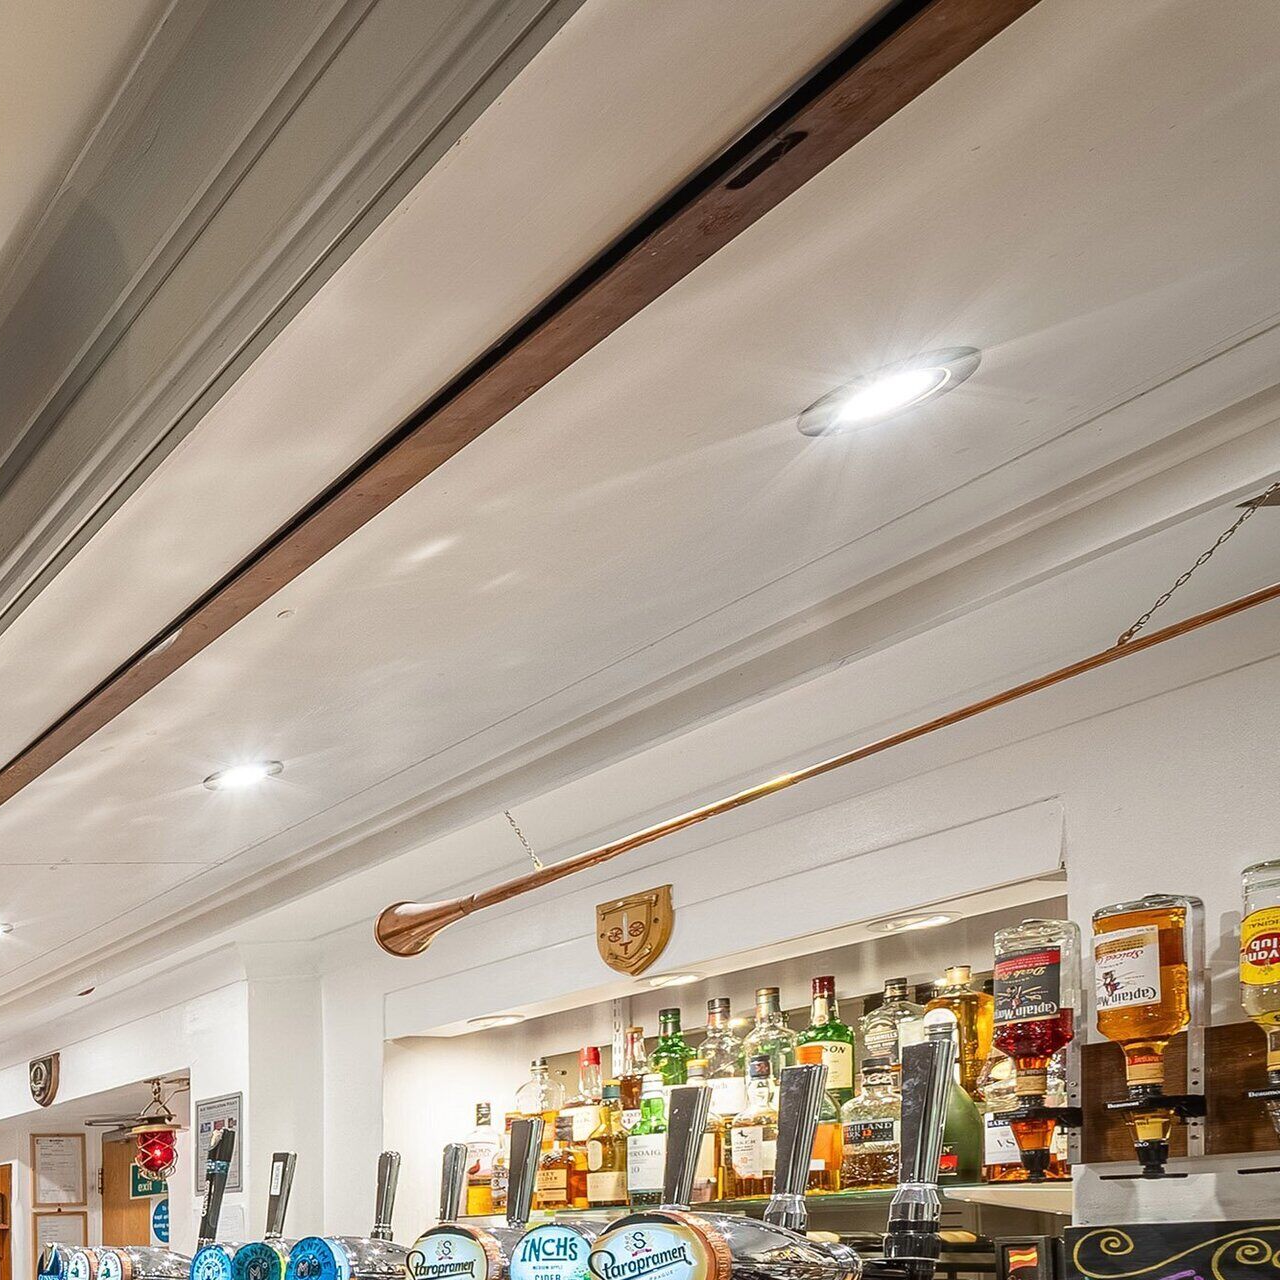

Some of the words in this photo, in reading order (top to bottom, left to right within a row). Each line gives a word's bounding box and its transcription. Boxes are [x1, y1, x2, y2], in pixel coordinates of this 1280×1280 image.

[1106, 949, 1144, 962] Spiced
[1111, 986, 1157, 1004] Captain
[1015, 1001, 1058, 1018] Captain
[137, 1182, 153, 1192] exit
[195, 1250, 227, 1274] MEANTIME
